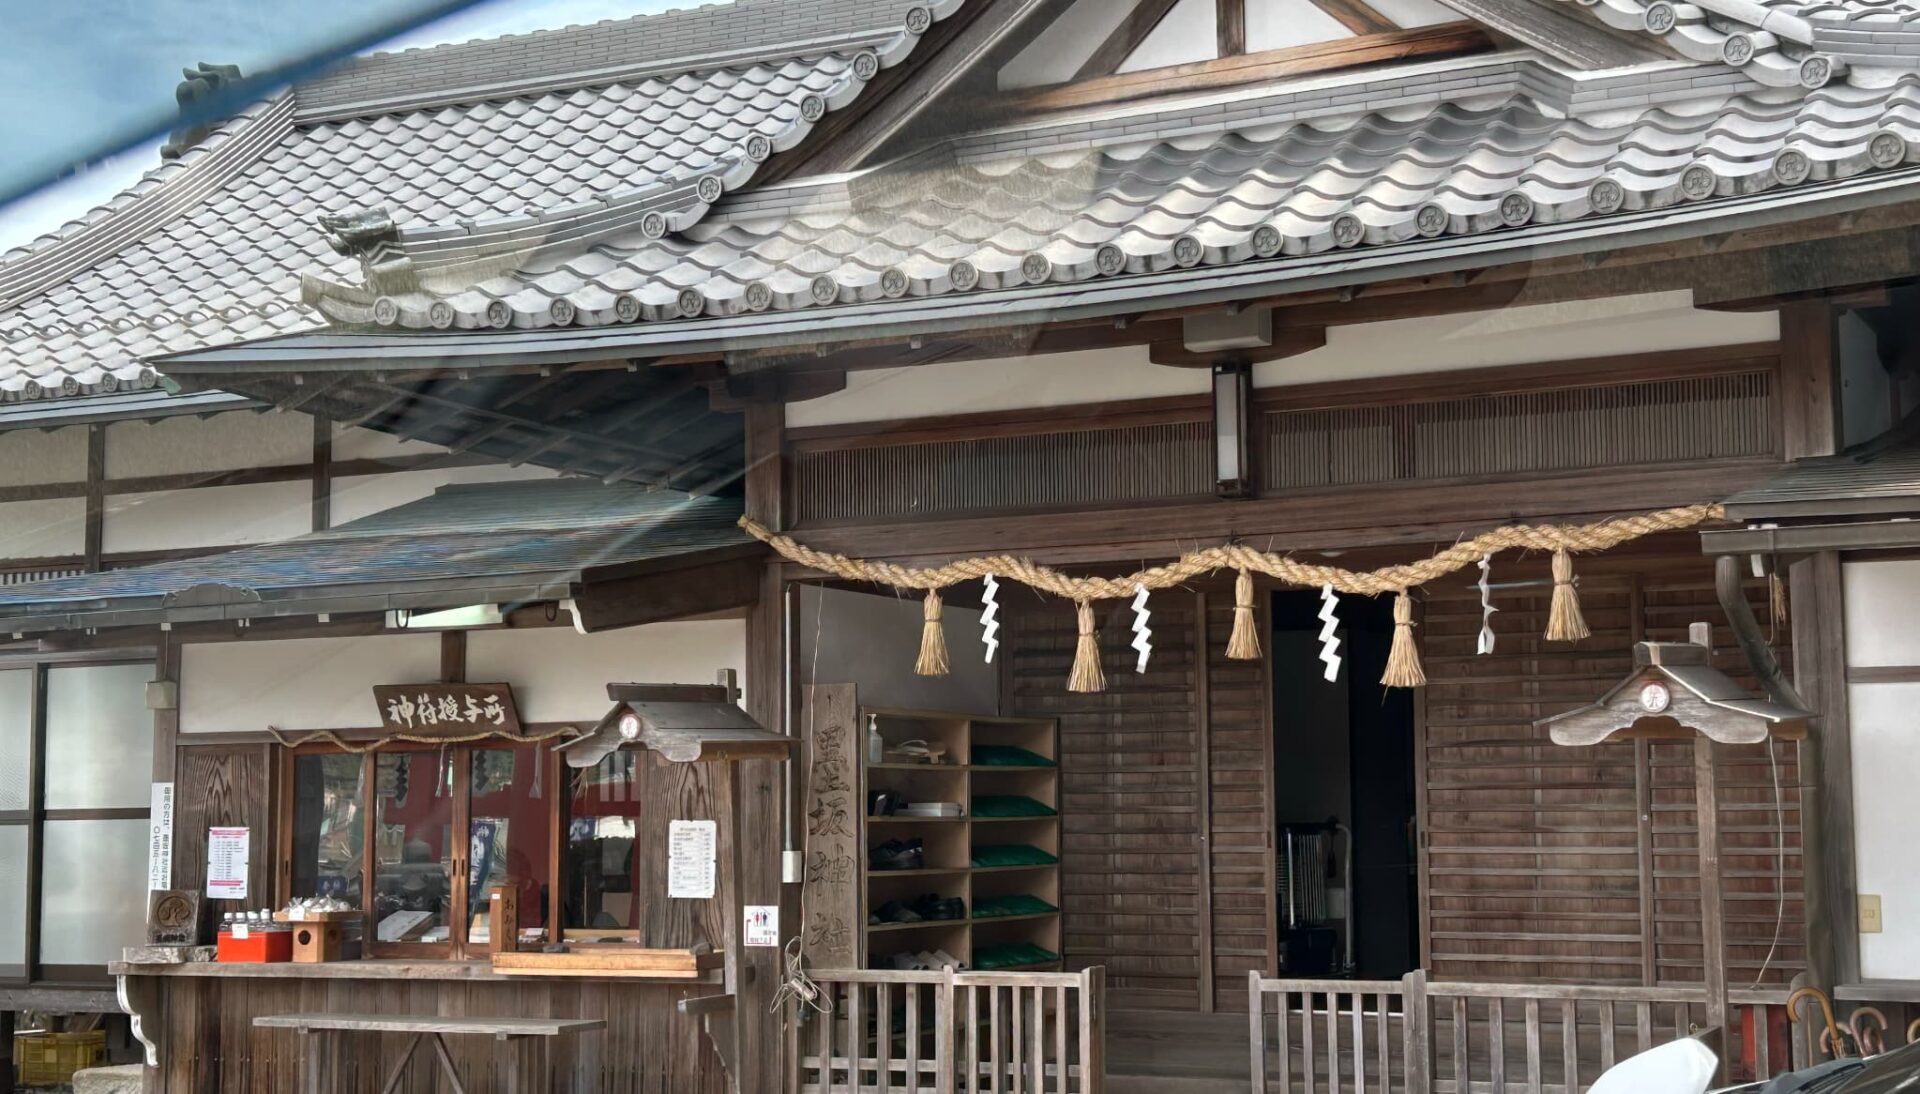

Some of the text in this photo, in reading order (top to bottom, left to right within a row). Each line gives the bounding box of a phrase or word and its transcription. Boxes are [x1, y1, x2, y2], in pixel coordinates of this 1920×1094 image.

[387, 692, 505, 729] 神符授与所
